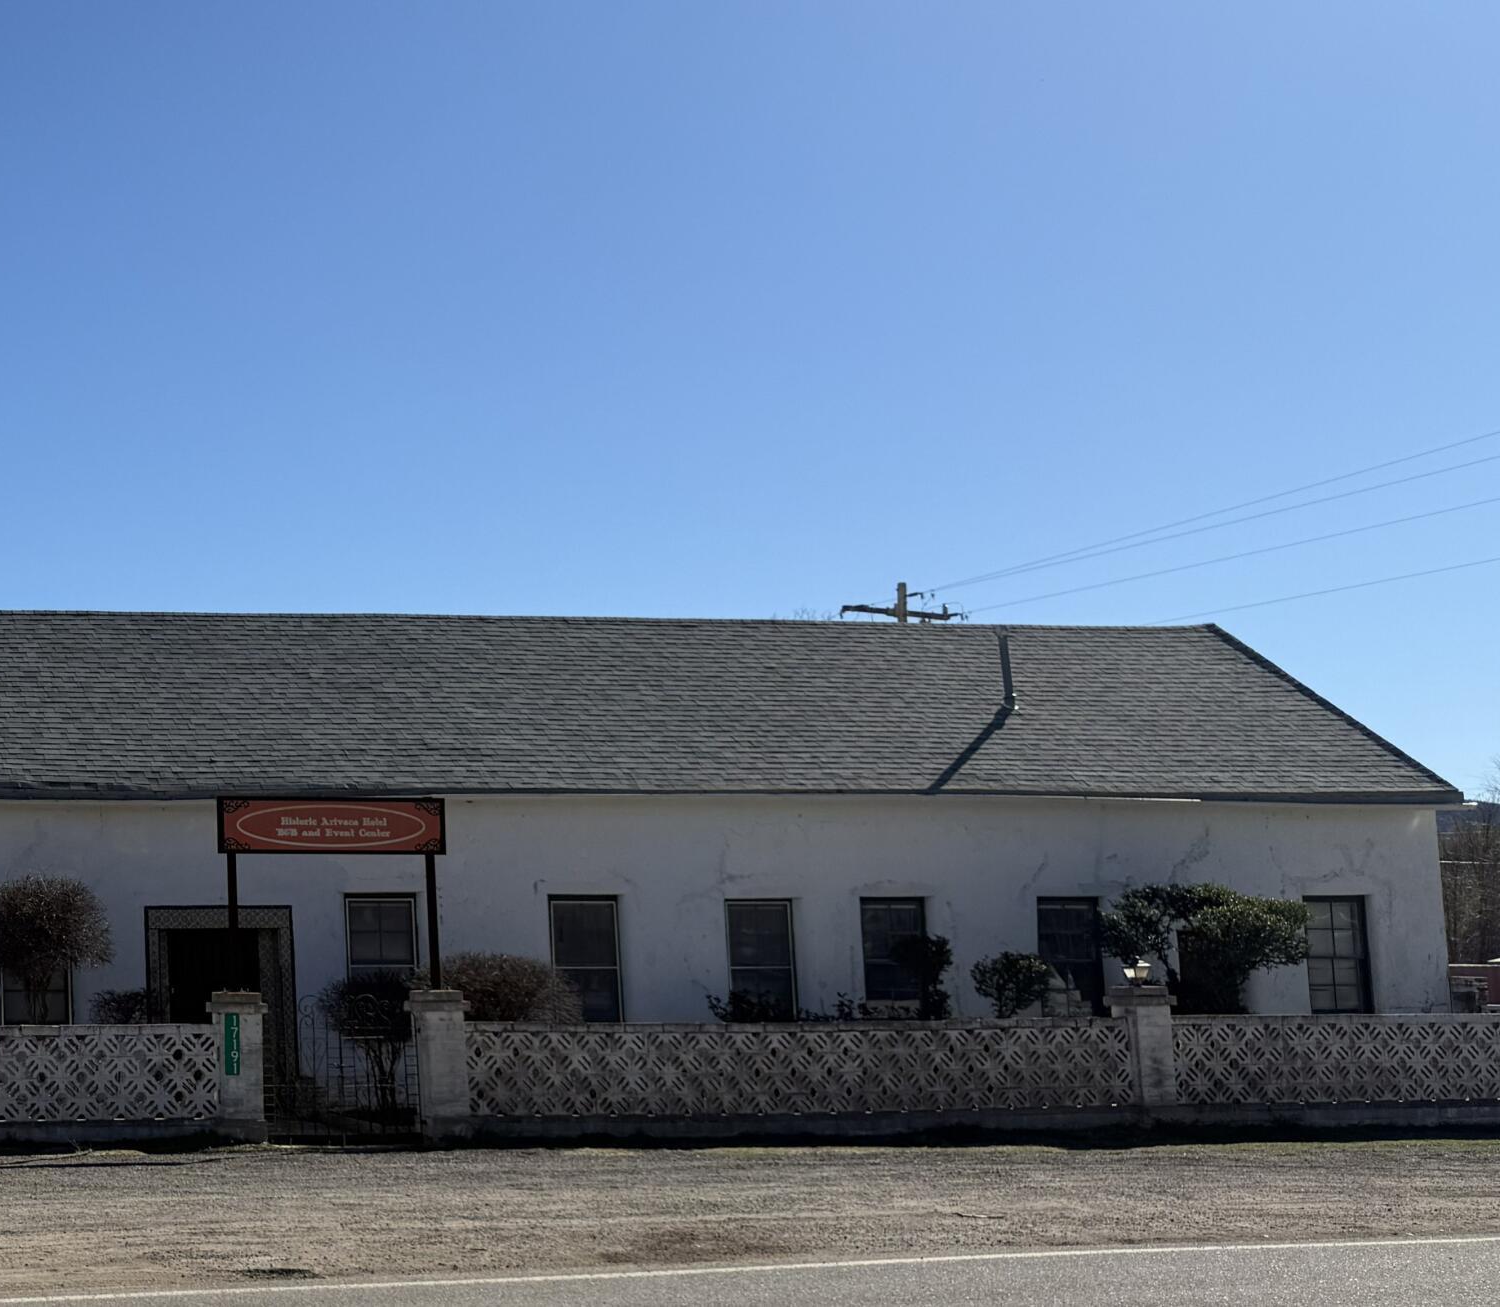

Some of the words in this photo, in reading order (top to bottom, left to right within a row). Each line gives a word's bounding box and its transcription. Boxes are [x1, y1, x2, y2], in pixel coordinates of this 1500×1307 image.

[280, 817, 317, 826] Historic
[362, 817, 388, 826] Hotel
[302, 828, 320, 837] and
[325, 828, 355, 837] Event
[359, 828, 391, 837] Center
[230, 1015, 239, 1075] 17191
